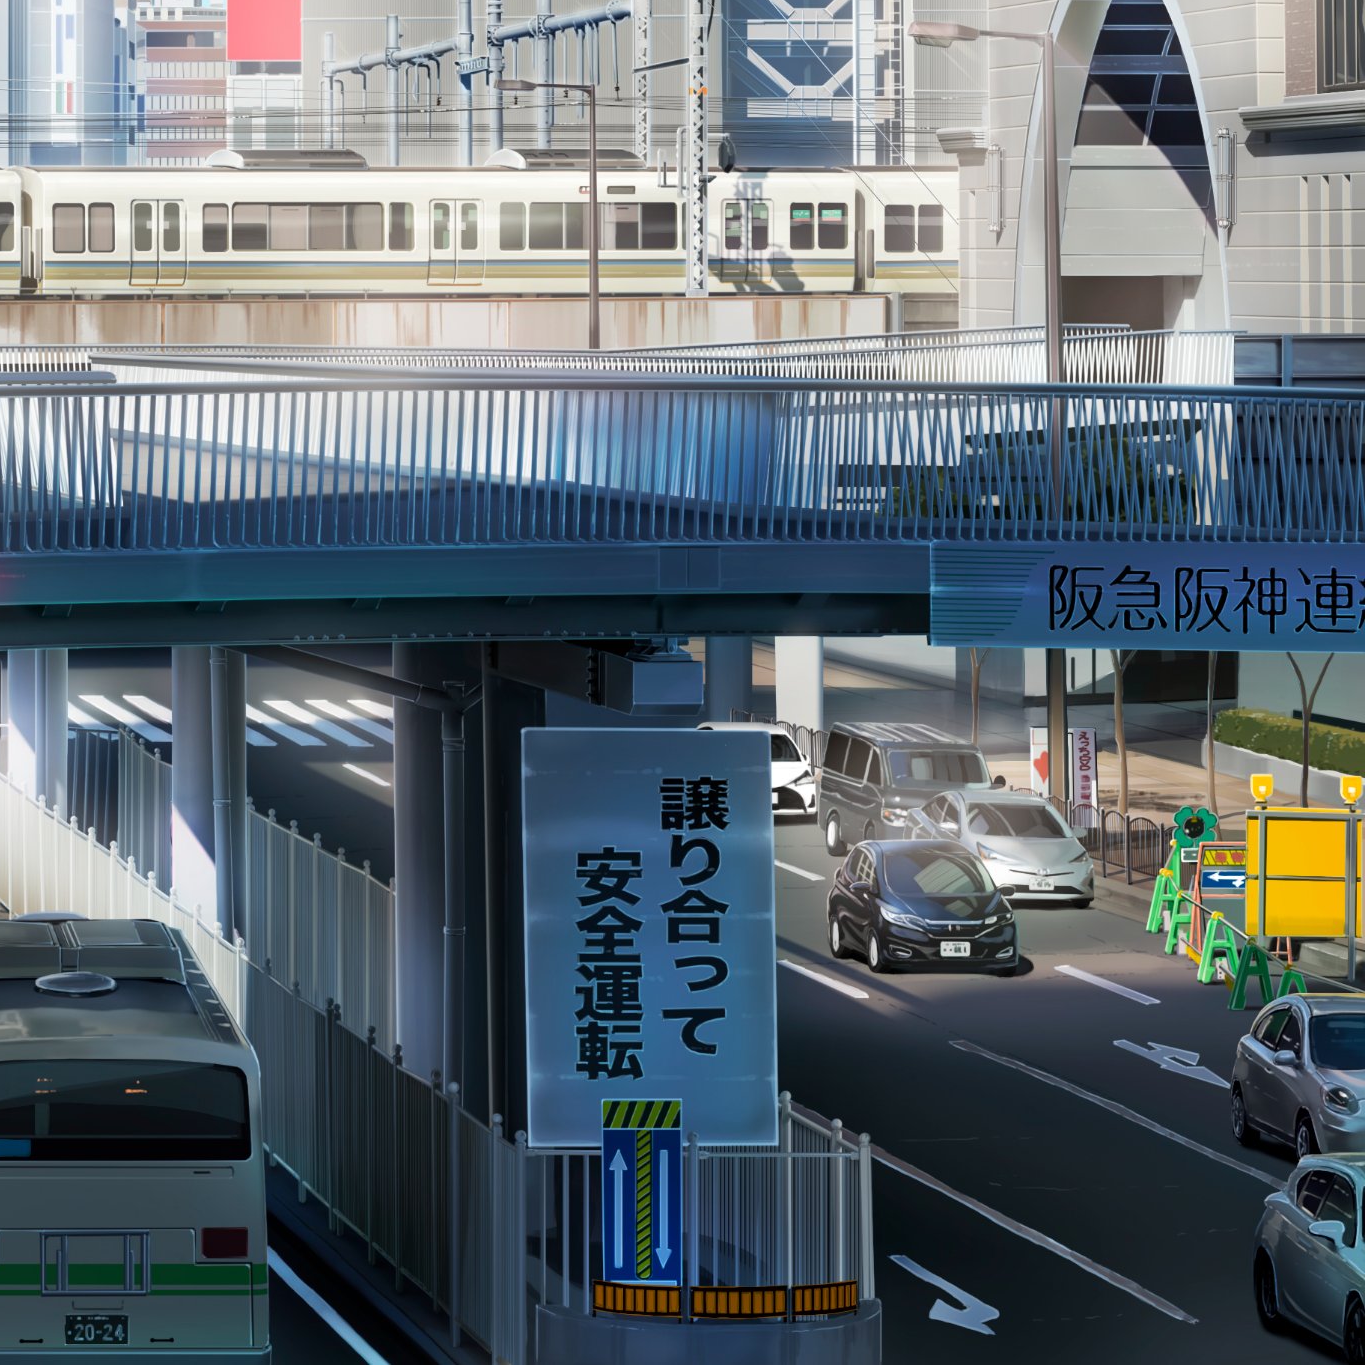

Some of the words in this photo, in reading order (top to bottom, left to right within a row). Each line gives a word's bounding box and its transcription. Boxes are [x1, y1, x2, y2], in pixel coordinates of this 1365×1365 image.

[1048, 564, 1365, 635] 阪急阪神連
[574, 845, 644, 1082] 安全運転
[658, 775, 730, 1057] 譲り合って
